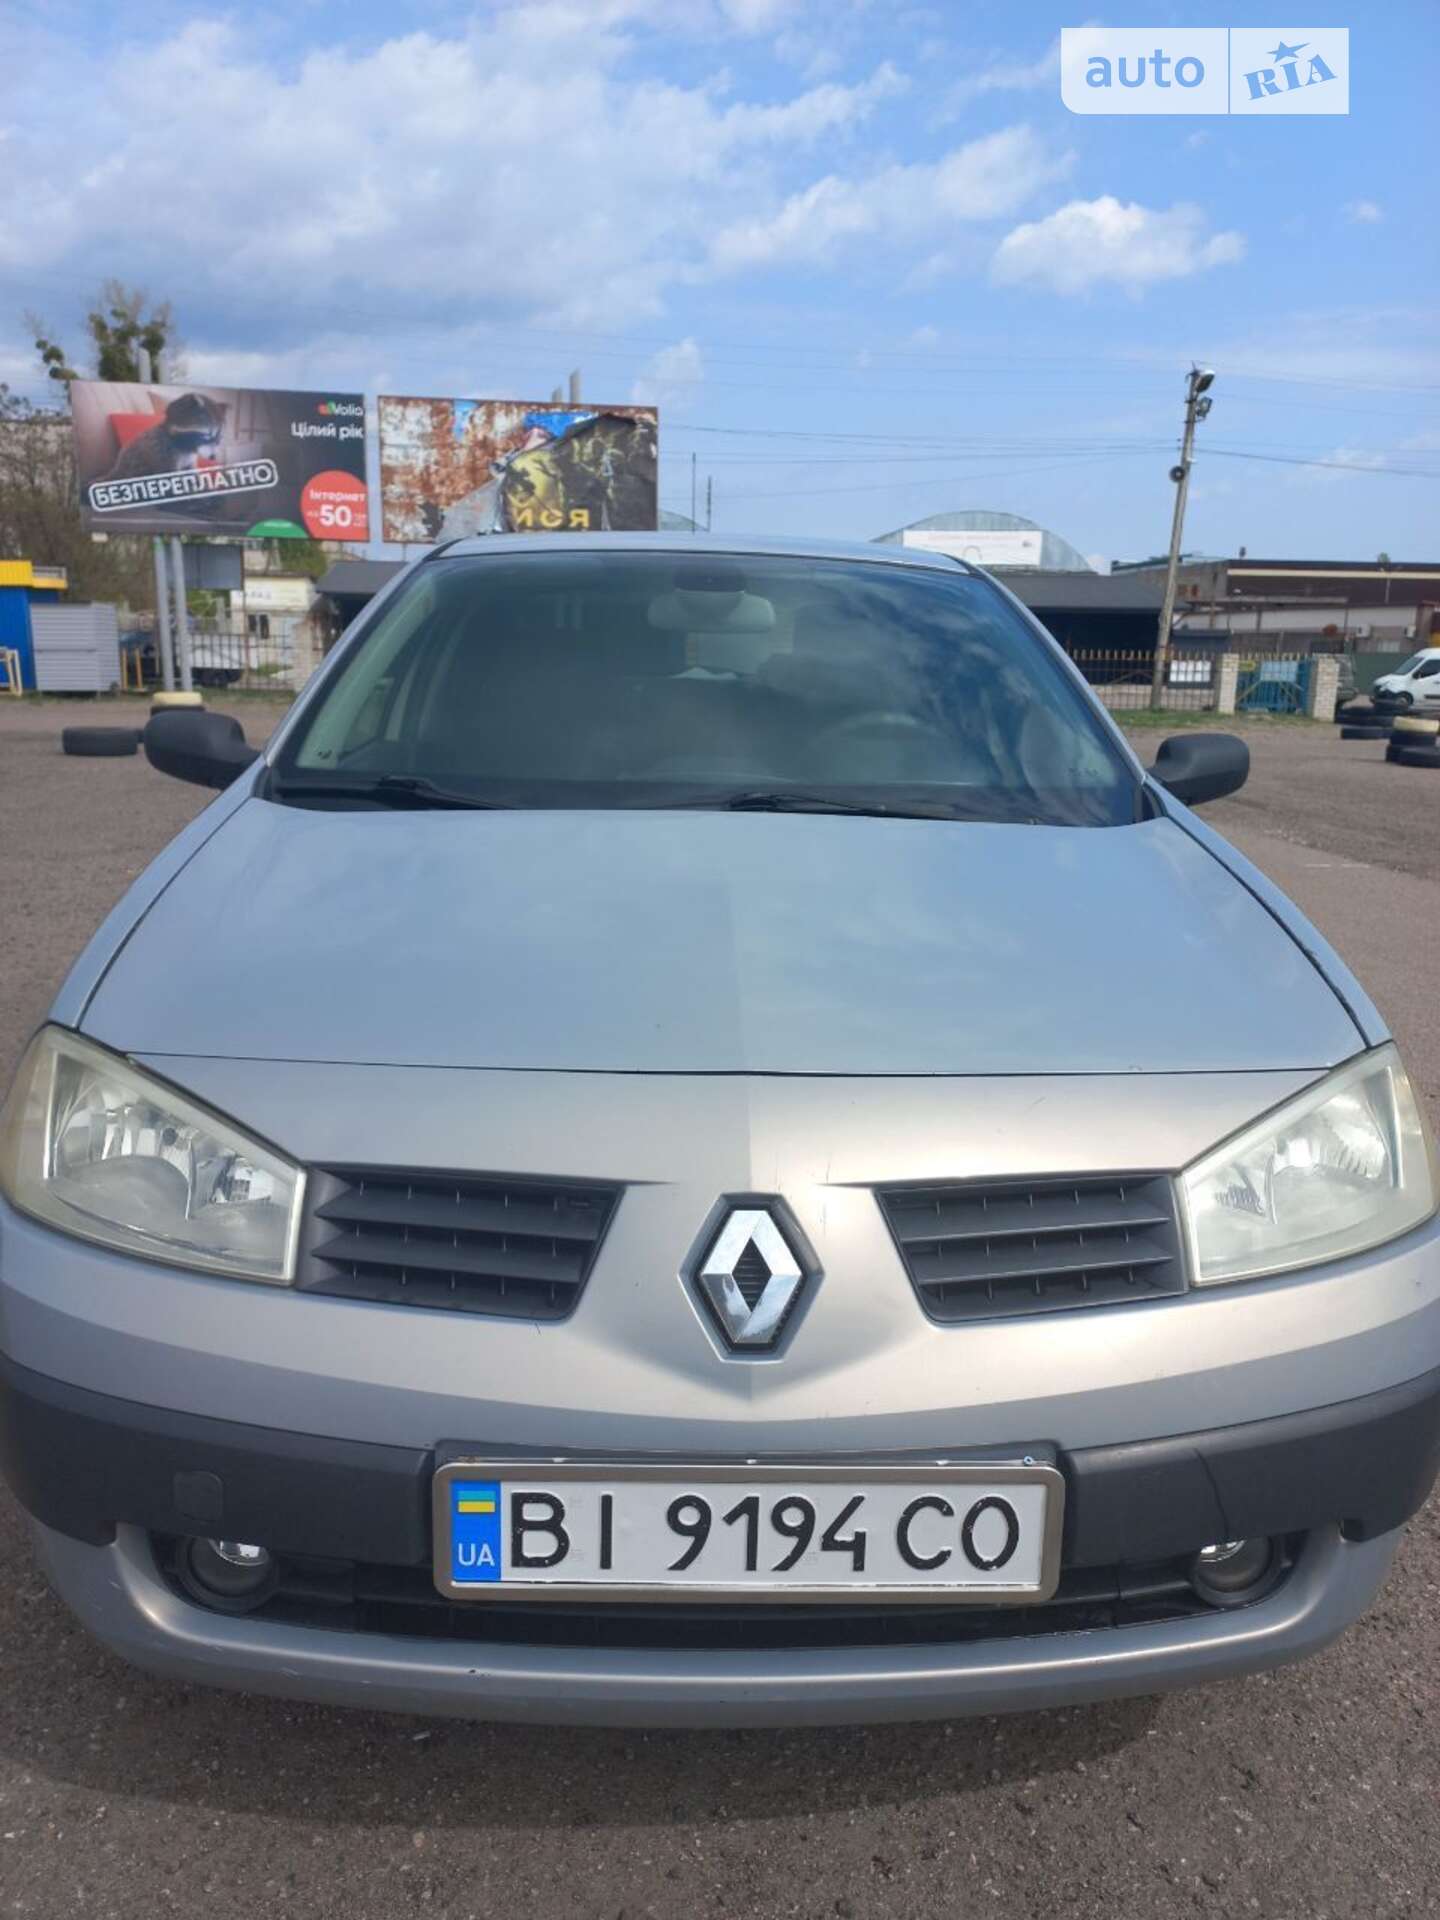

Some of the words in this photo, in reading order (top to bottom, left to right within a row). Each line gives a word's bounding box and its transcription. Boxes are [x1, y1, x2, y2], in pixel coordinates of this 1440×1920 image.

[291, 421, 337, 438] Цілий
[339, 423, 364, 440] рік
[95, 464, 272, 505] БЕЗПЕРЕПЛАТНО
[319, 504, 352, 527] 50
[510, 1491, 614, 1570] BI
[665, 1494, 867, 1573] 9194
[896, 1495, 1021, 1572] CO
[458, 1544, 496, 1568] UA
